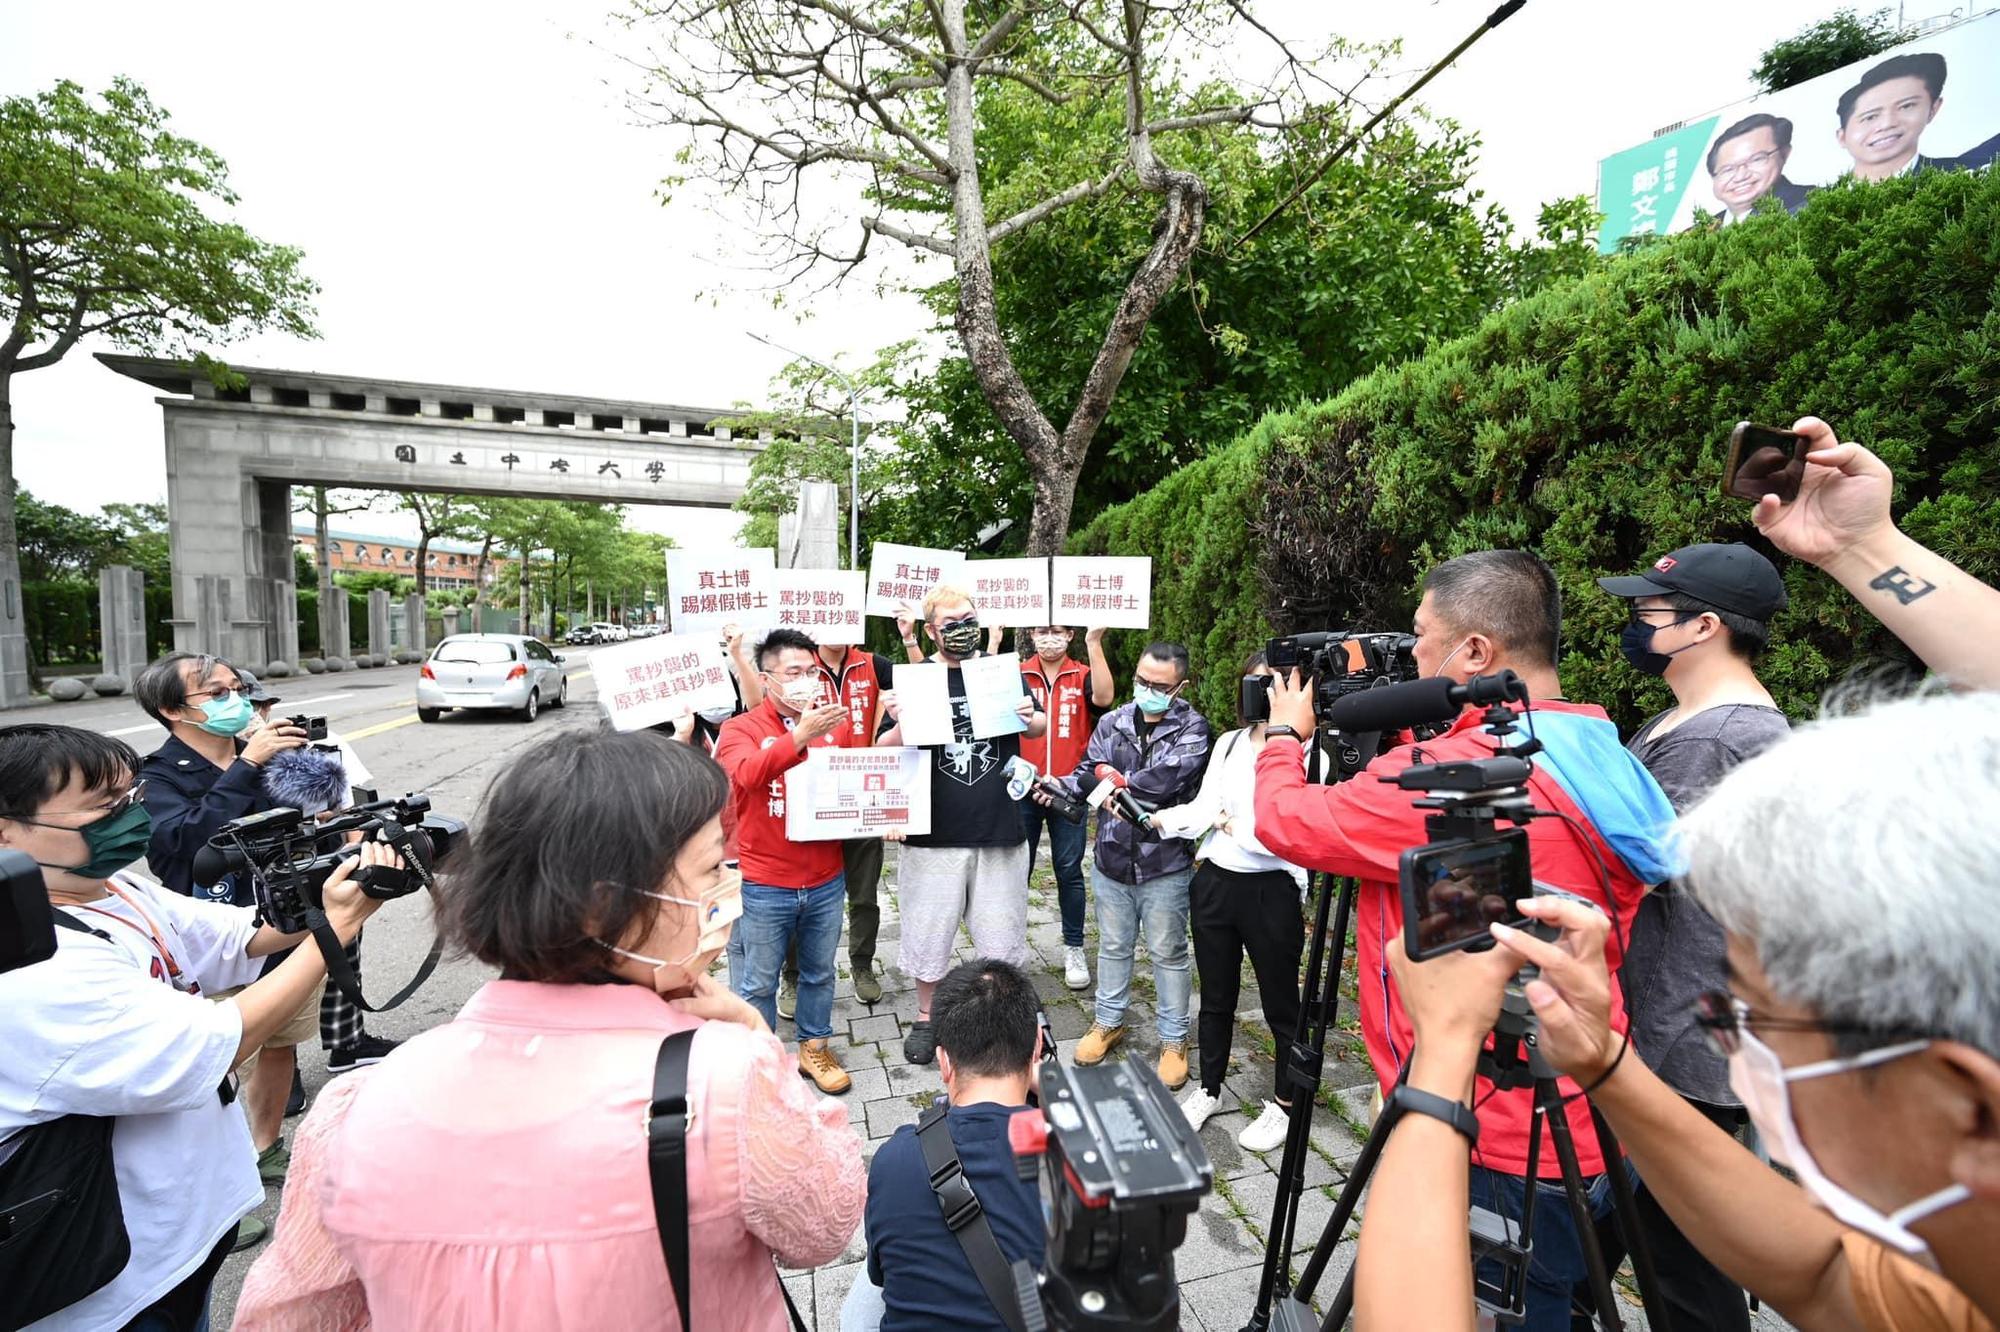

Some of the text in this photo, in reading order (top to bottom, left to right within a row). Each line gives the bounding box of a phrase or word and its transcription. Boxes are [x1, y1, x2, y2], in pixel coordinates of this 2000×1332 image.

[395, 444, 665, 483] 國立中央大學
[698, 569, 750, 589] 真士博
[895, 564, 940, 583] 真士博
[1077, 574, 1124, 591] 真士博
[976, 578, 1029, 593] 罵抄襲的
[681, 591, 768, 615] 踢爆假博士
[779, 590, 844, 606] 罵抄襲的
[971, 594, 1043, 610] 來是真抄襲
[1061, 593, 1139, 610] 踢爆假博士
[779, 609, 860, 625] 來是真抄襲
[626, 652, 700, 685] 罵抄襲的
[614, 667, 725, 710] 原來是真抄襲
